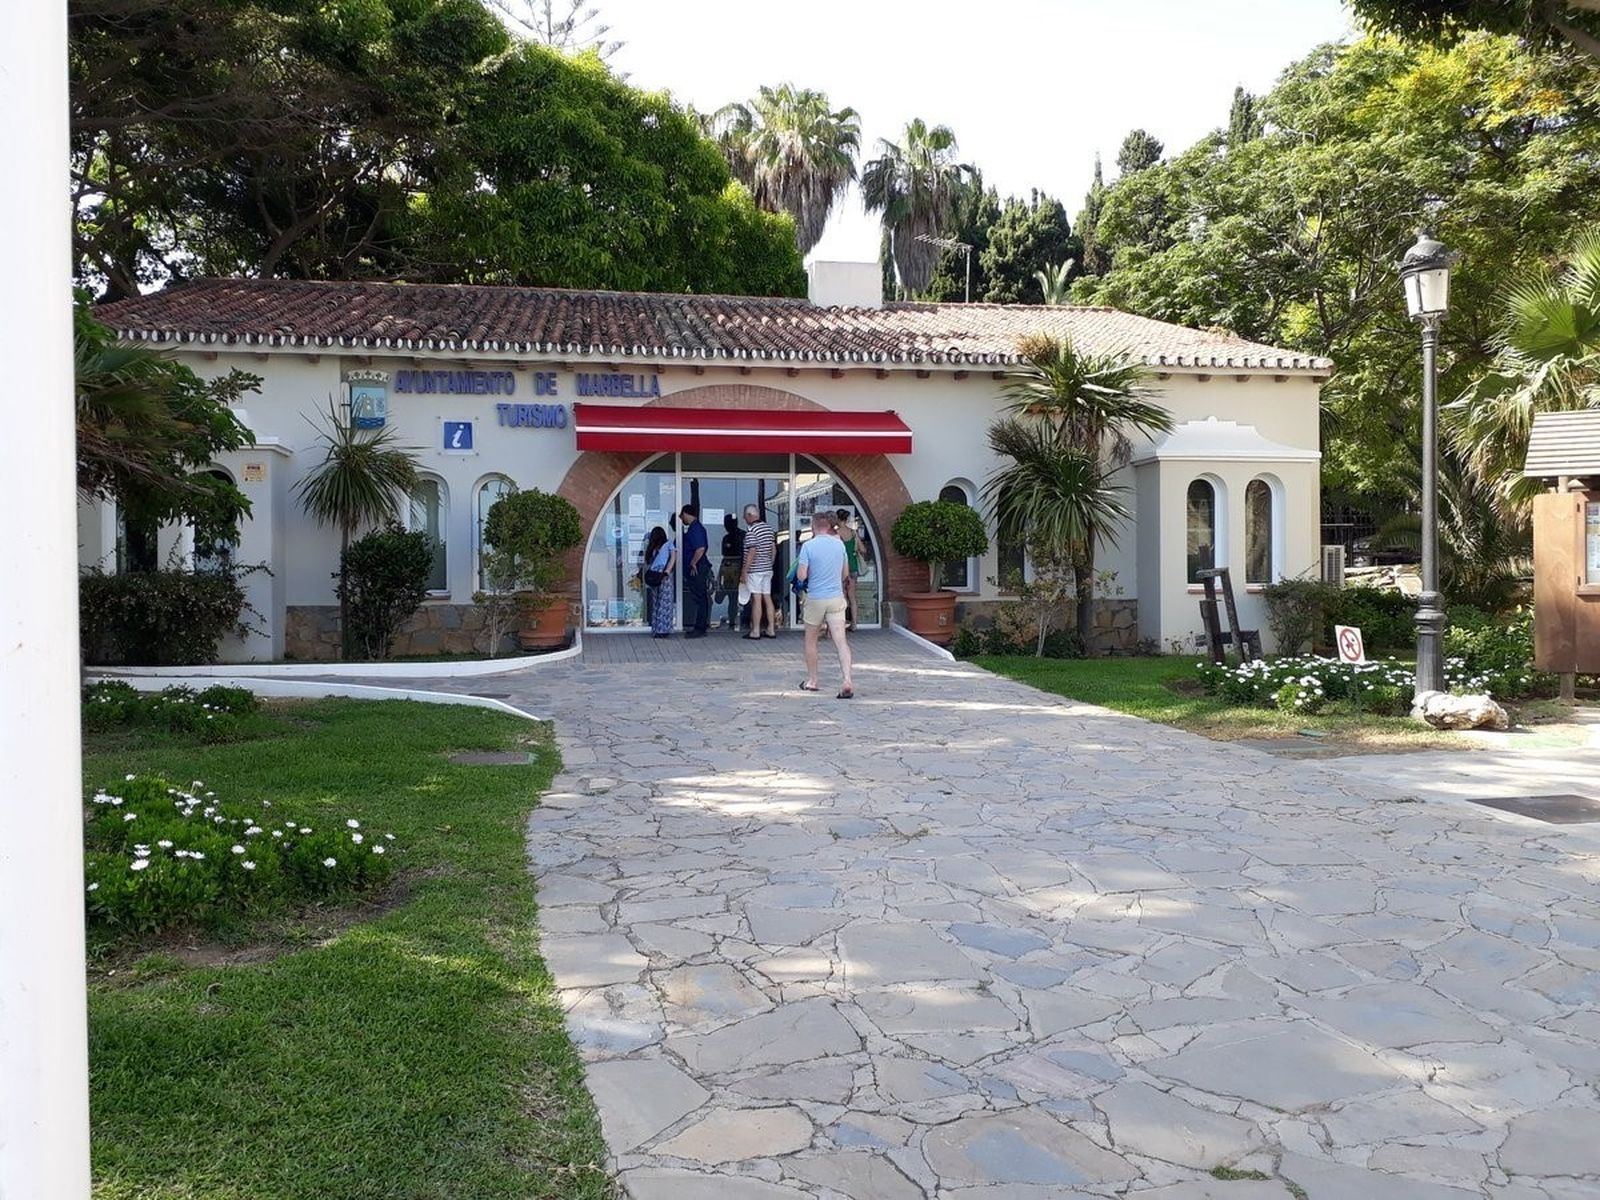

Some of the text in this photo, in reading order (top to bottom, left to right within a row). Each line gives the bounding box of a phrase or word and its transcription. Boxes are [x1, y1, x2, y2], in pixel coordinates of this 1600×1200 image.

[395, 370, 661, 397] AYUNTAMIENTO DE MARBELLA
[496, 403, 568, 429] TURISMO
